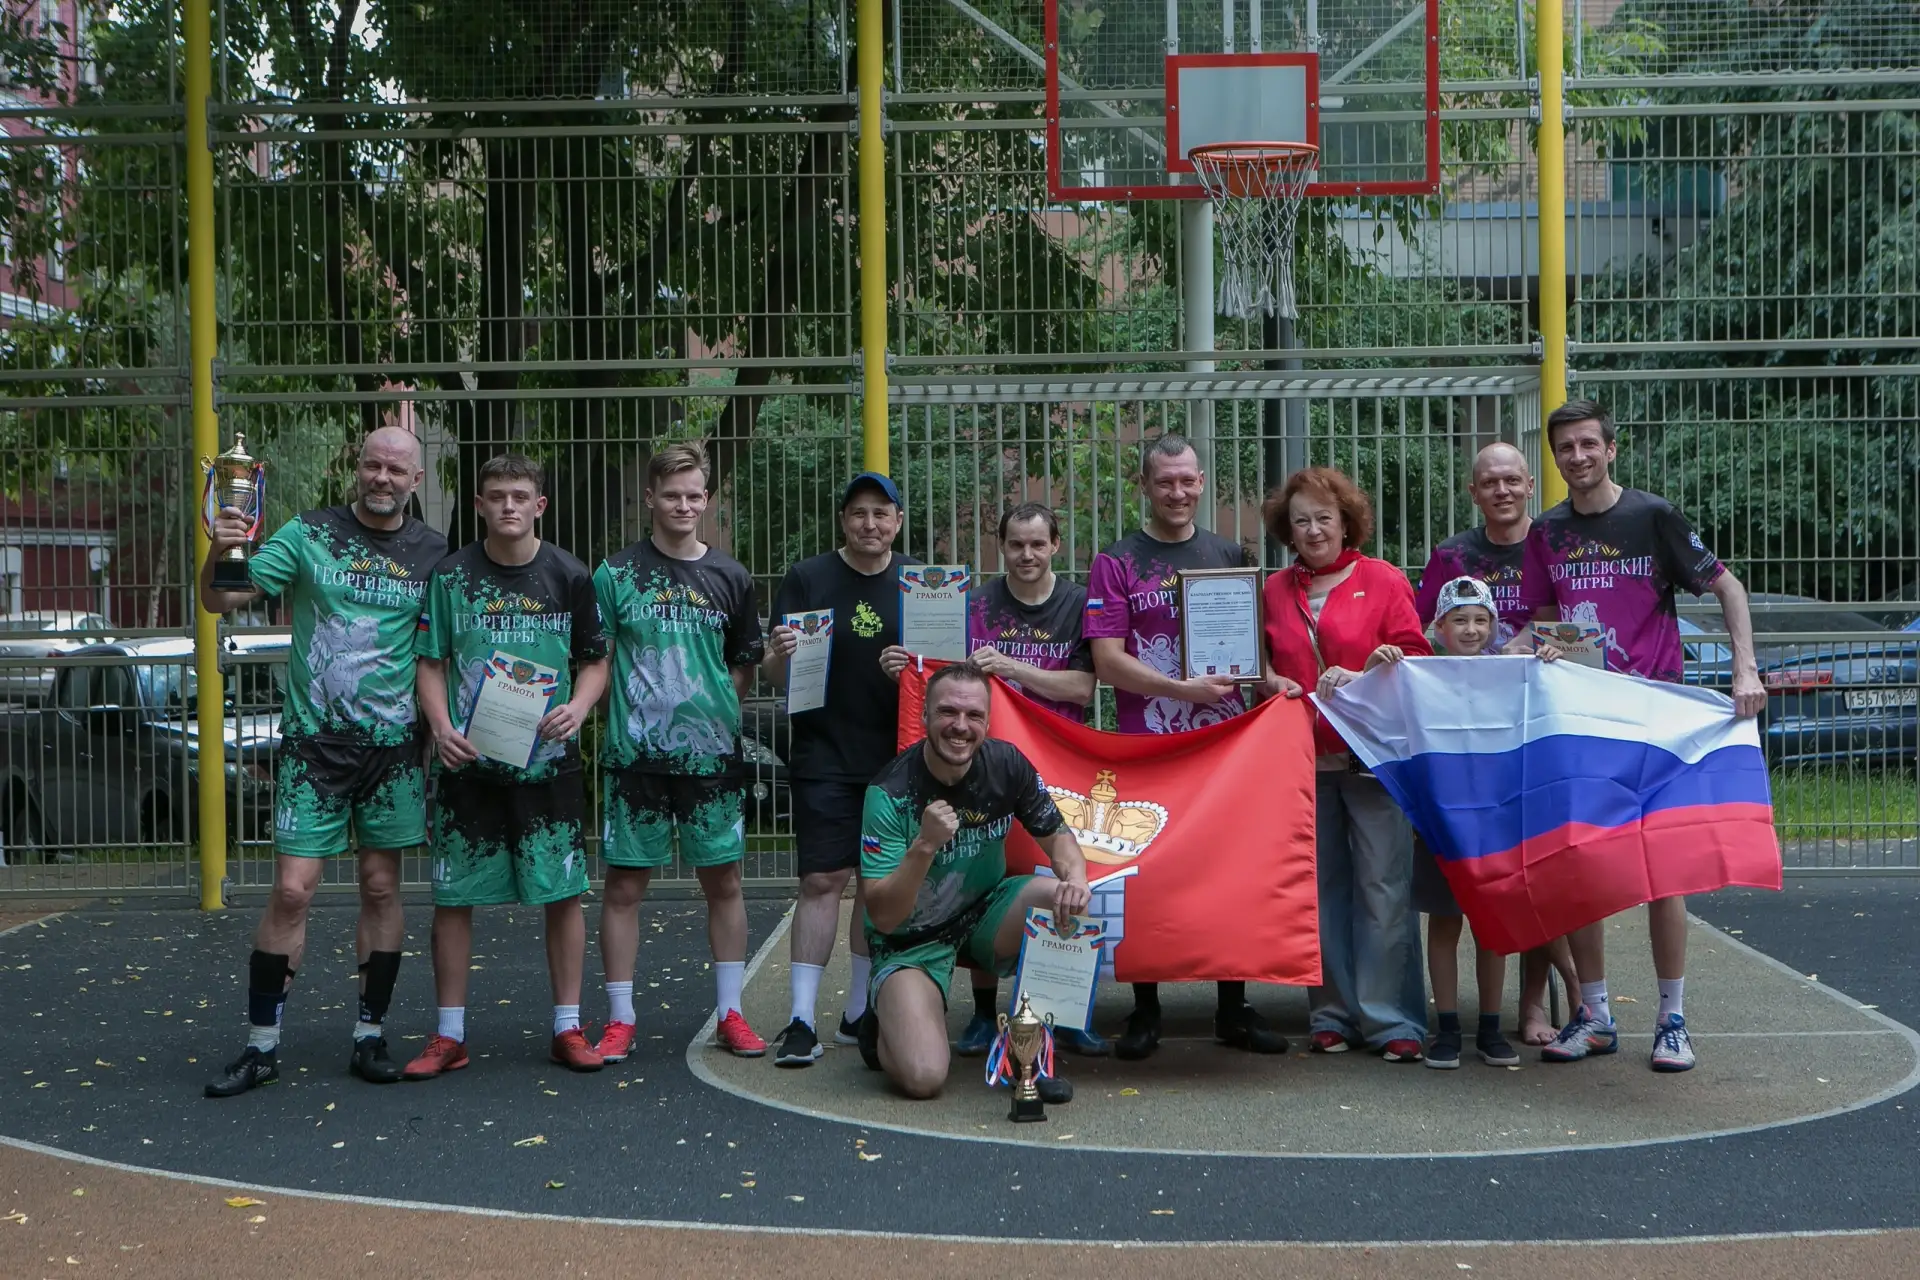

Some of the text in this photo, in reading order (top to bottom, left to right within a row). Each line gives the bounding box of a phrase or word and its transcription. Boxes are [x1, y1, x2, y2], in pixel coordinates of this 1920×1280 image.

[313, 563, 428, 600] ГЕОРГИЕВСКИ
[1571, 576, 1613, 590] ИГРЫ
[354, 589, 401, 607] ИГРЫ
[455, 611, 572, 634] ГЕОРГИЕВСКИЕ
[661, 621, 701, 634] ИГРЫ
[490, 631, 535, 643] ИГРЫ
[799, 637, 823, 647] ГРАМОТА
[497, 681, 535, 699] ГРАМОТА
[1041, 939, 1083, 954] ГРАМОТА
